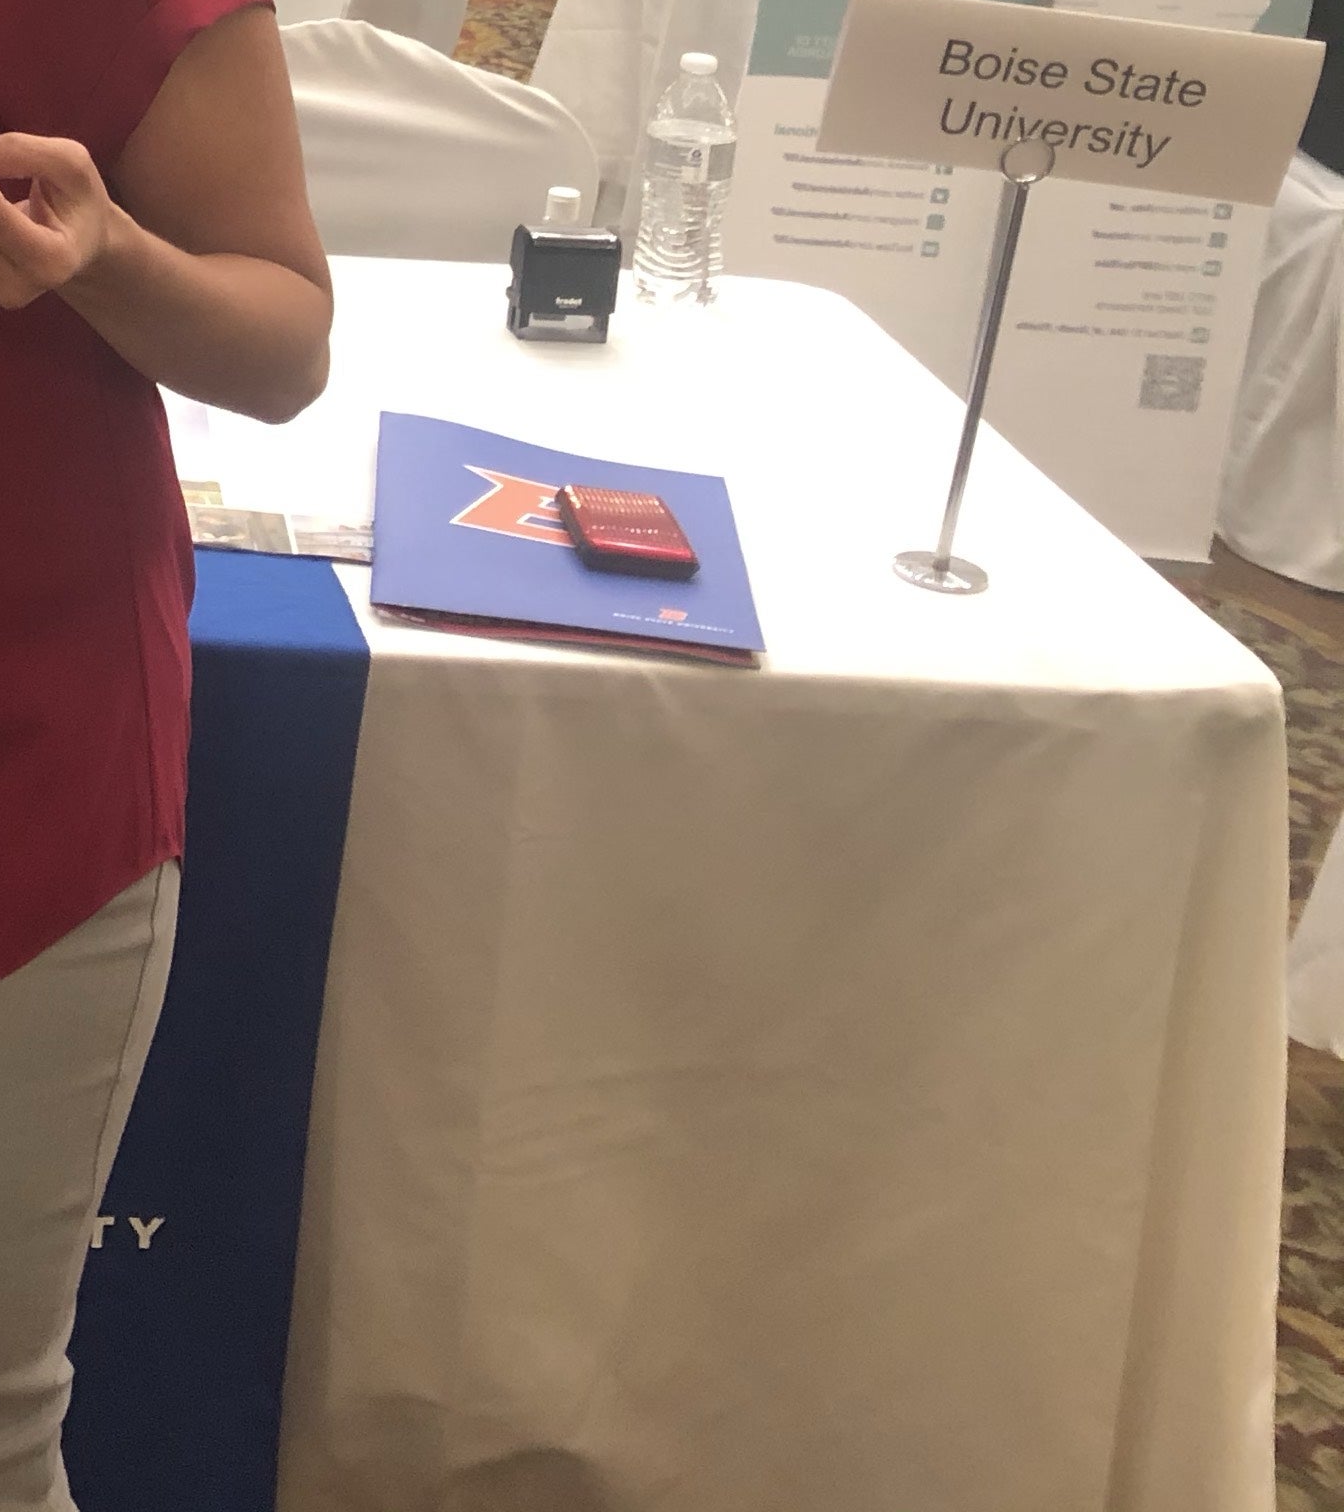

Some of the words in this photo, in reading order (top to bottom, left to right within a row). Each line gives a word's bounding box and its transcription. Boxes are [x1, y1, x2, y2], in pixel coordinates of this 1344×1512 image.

[939, 38, 1069, 89] Boise
[1084, 58, 1207, 108] State
[939, 97, 1172, 169] University
